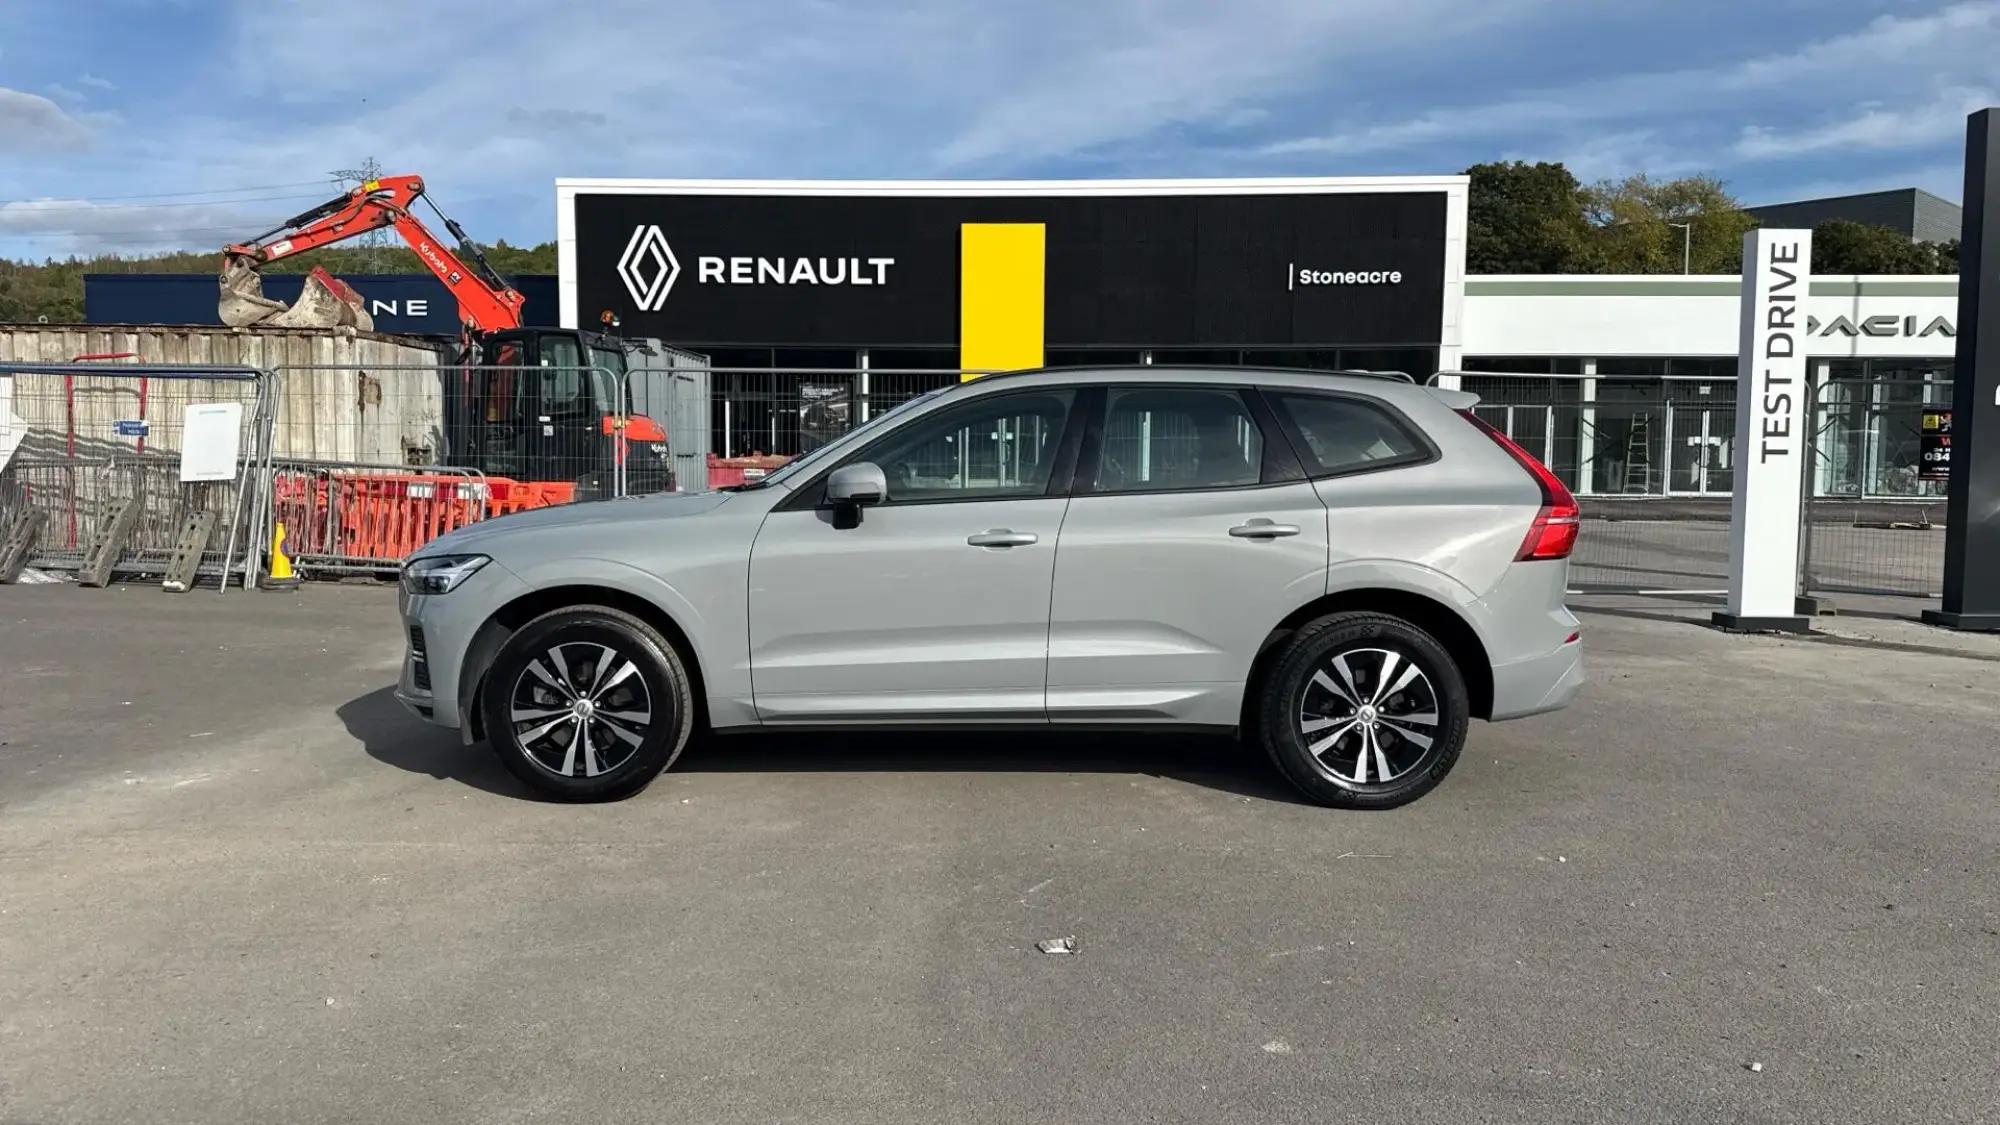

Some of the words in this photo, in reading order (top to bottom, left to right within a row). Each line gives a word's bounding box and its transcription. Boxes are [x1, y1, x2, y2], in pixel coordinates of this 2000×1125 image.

[420, 241, 448, 273] Kubota
[698, 256, 895, 285] RENAULT
[1299, 269, 1402, 284] Stoneacre
[1766, 242, 1798, 360] DRIVE
[1761, 370, 1793, 464] TEST
